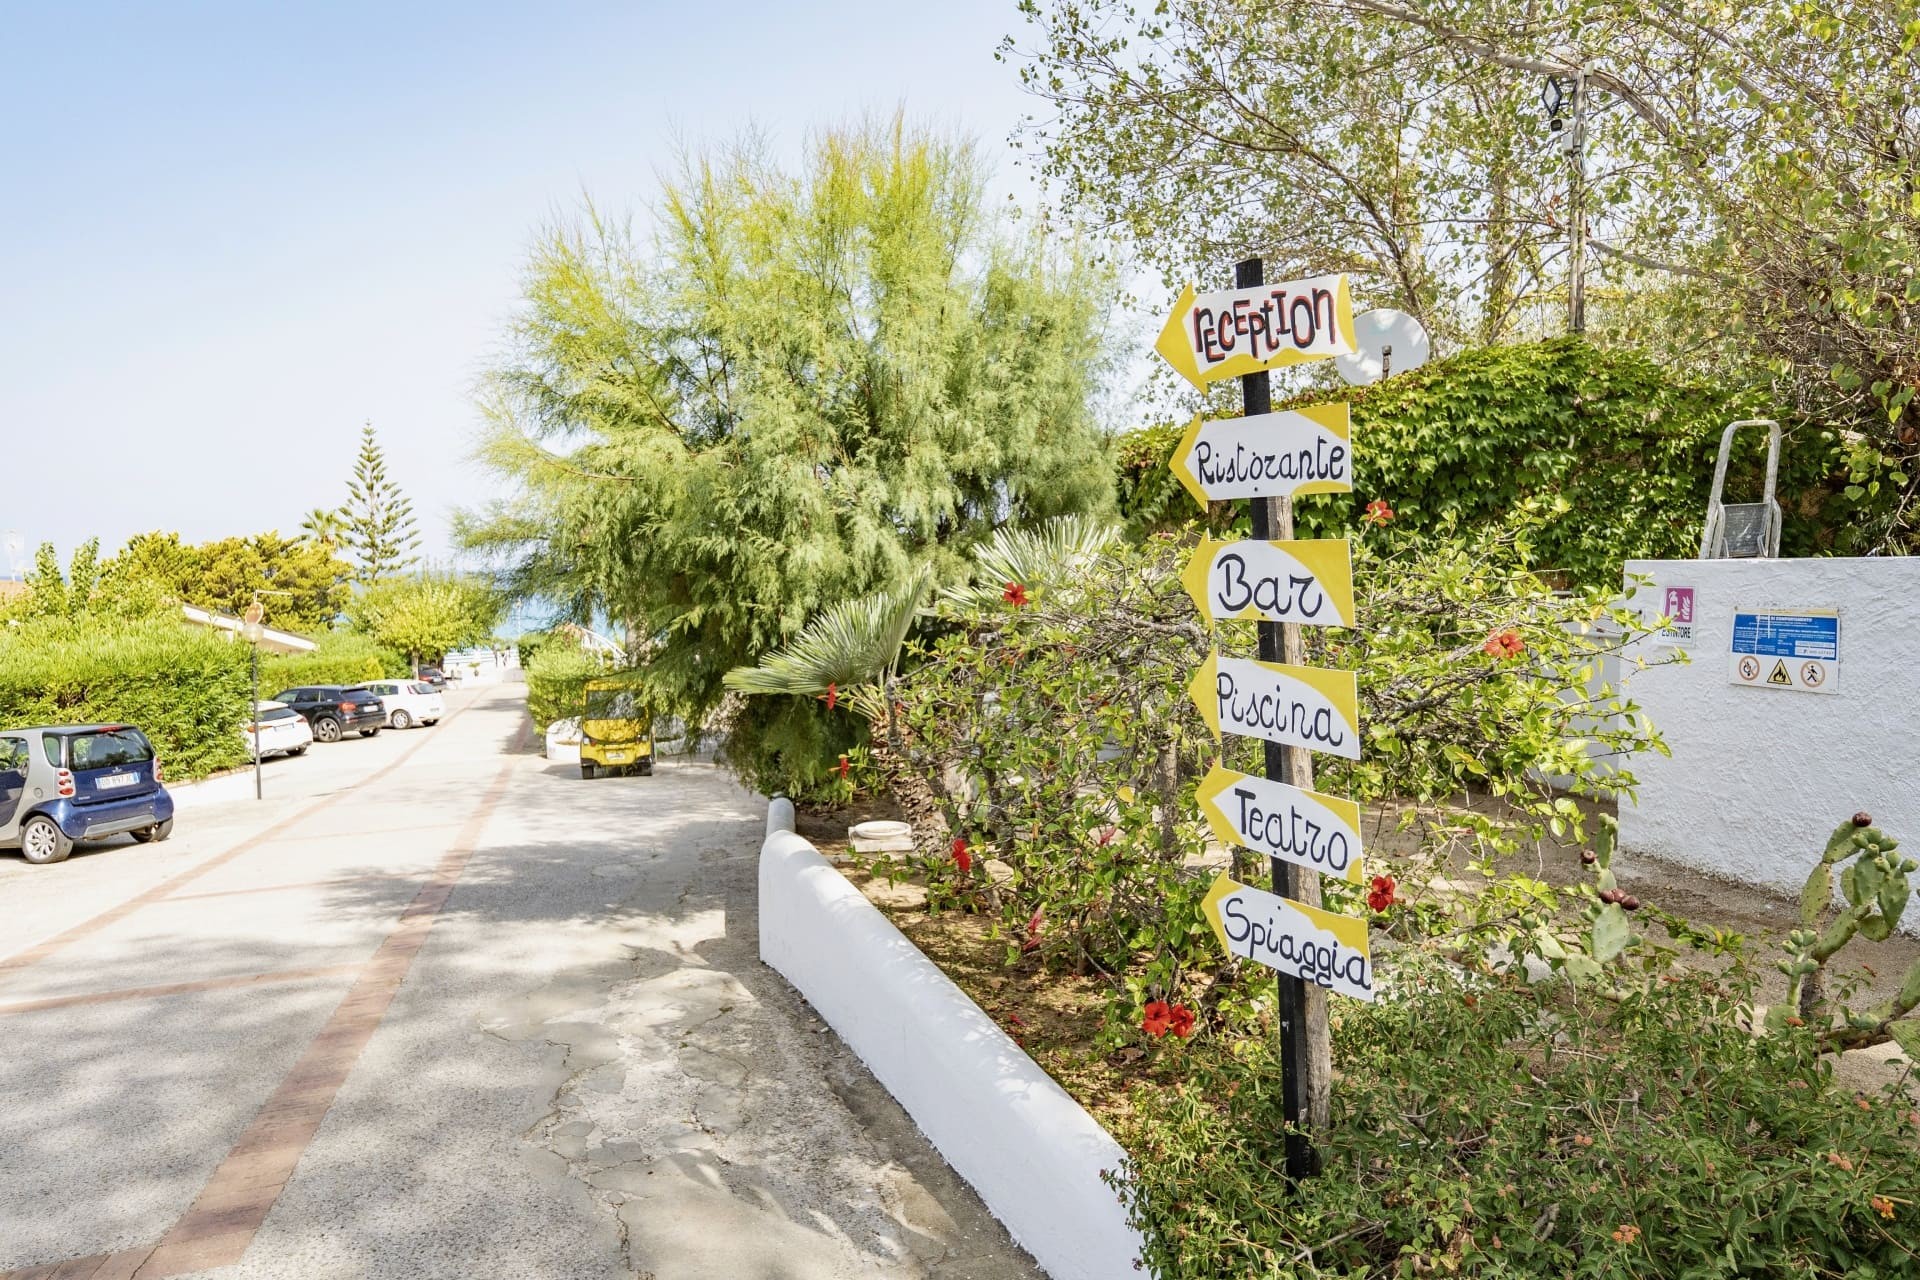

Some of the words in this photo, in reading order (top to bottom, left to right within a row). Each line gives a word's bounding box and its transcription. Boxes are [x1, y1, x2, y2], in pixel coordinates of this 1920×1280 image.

[1195, 435, 1345, 486] Ristorante
[1217, 553, 1323, 619] Bar
[1217, 672, 1343, 748] Piscina
[1235, 788, 1348, 872] Teatro
[1224, 897, 1371, 989] Spiaggia
